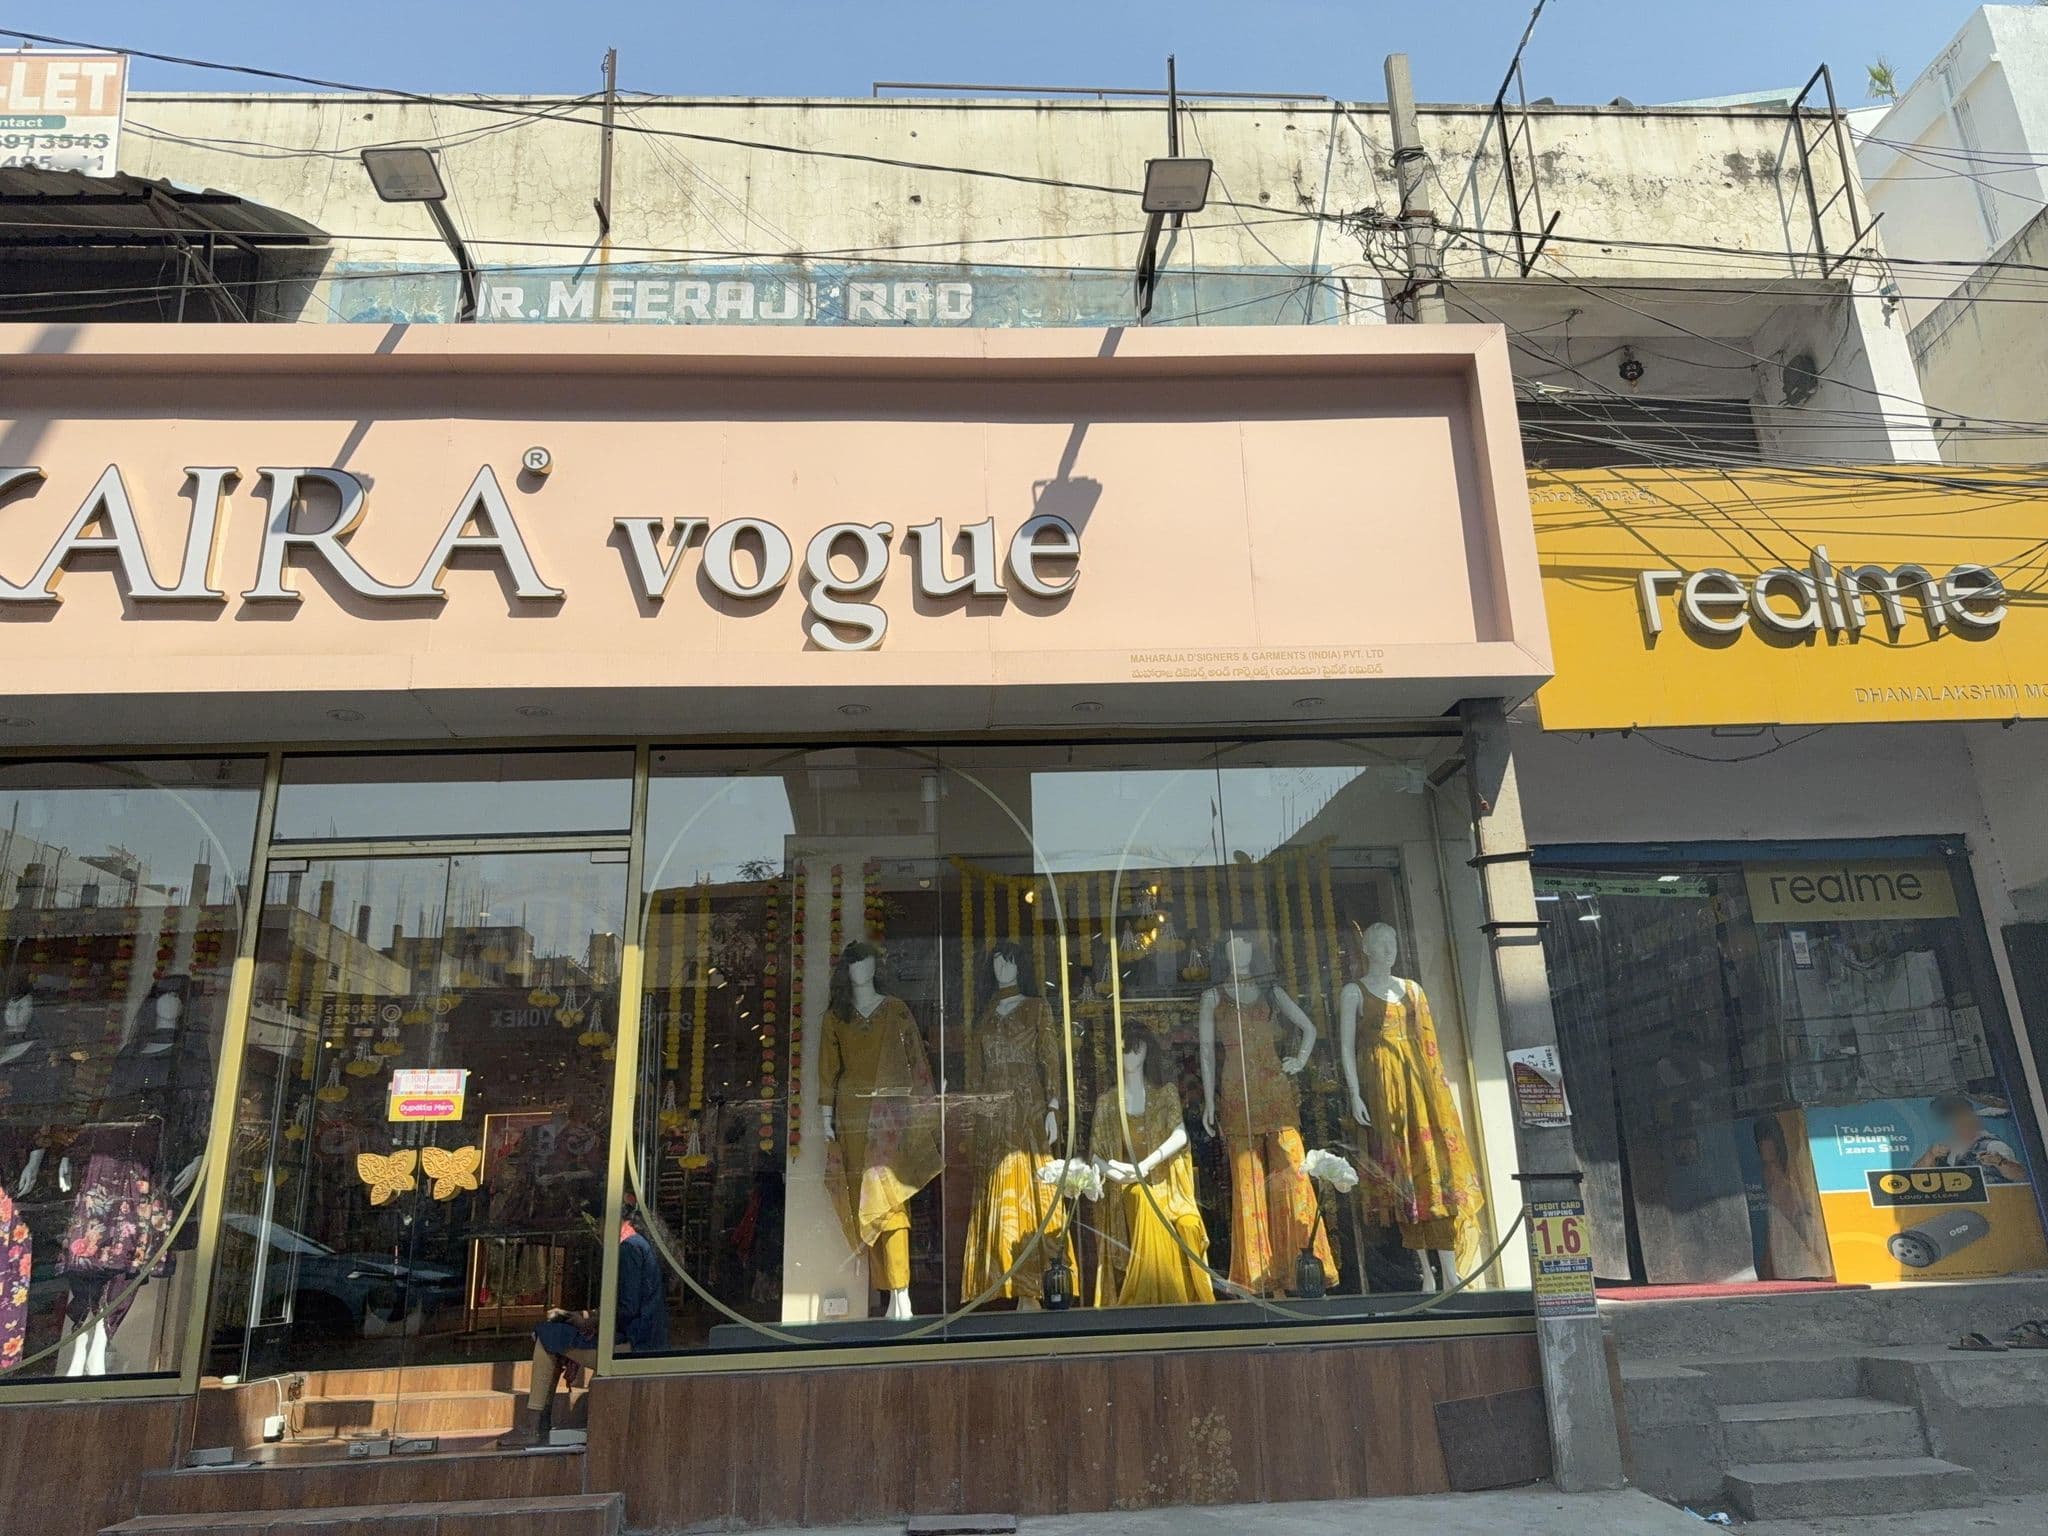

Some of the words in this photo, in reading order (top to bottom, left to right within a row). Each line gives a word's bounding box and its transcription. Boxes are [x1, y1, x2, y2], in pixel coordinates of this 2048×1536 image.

[848, 282, 973, 320] RAO
[613, 514, 1082, 651] vogue
[1636, 544, 2009, 636] realme
[1130, 654, 1185, 664] MAHARAJA
[1187, 653, 1240, 663] D'SIGNERS
[1242, 652, 1249, 661] &
[1251, 651, 1306, 661] GARMENTS
[1308, 650, 1341, 661] (INDIA)
[1855, 684, 2020, 703] DHANALAKSHMI
[1769, 868, 1923, 904] realme
[1841, 1126, 1858, 1134] Tu
[1863, 1124, 1895, 1134] Apni
[1843, 1134, 1887, 1144] Dhun
[1890, 1134, 1908, 1142] ko
[1878, 1144, 1910, 1153] Sun
[1879, 1172, 1973, 1195] OUD
[1534, 1202, 1560, 1211] CREDIT
[1561, 1201, 1581, 1210] CARD
[1543, 1209, 1574, 1217] SWIPING
